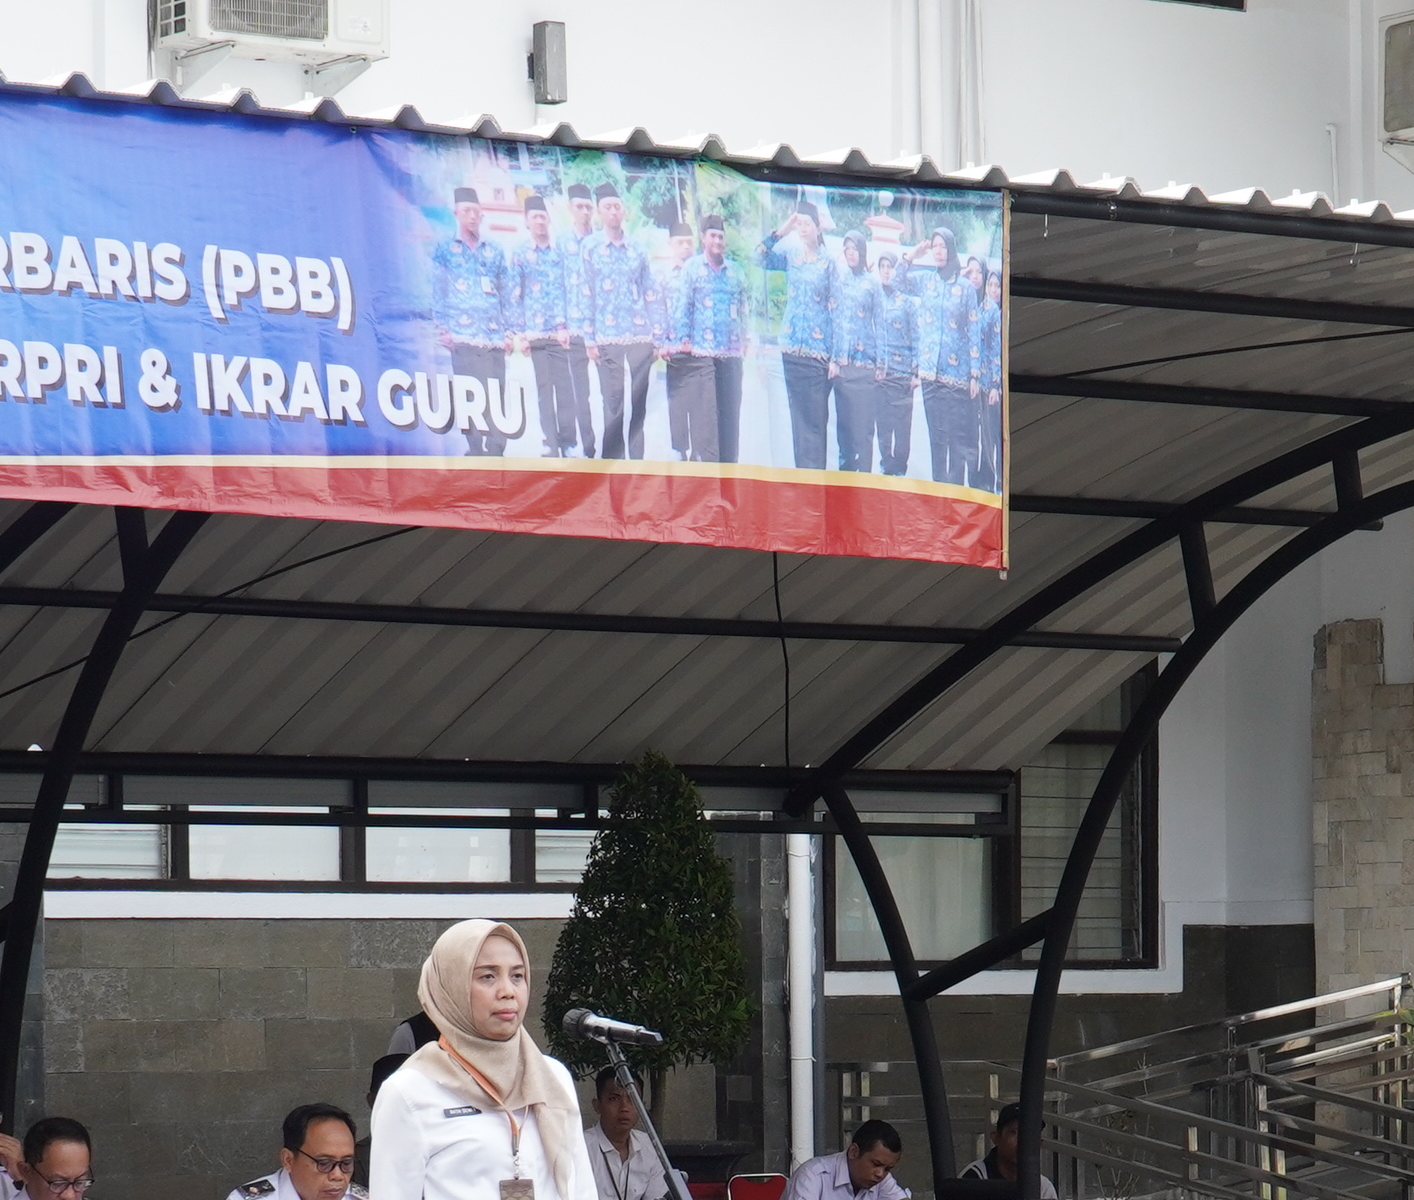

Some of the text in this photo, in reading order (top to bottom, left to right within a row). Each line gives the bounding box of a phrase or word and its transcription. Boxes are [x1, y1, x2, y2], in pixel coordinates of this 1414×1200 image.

[201, 244, 353, 331] (PBB)
[138, 348, 177, 409] &
[193, 352, 365, 422] IKRAR
[376, 368, 527, 436] GURU
